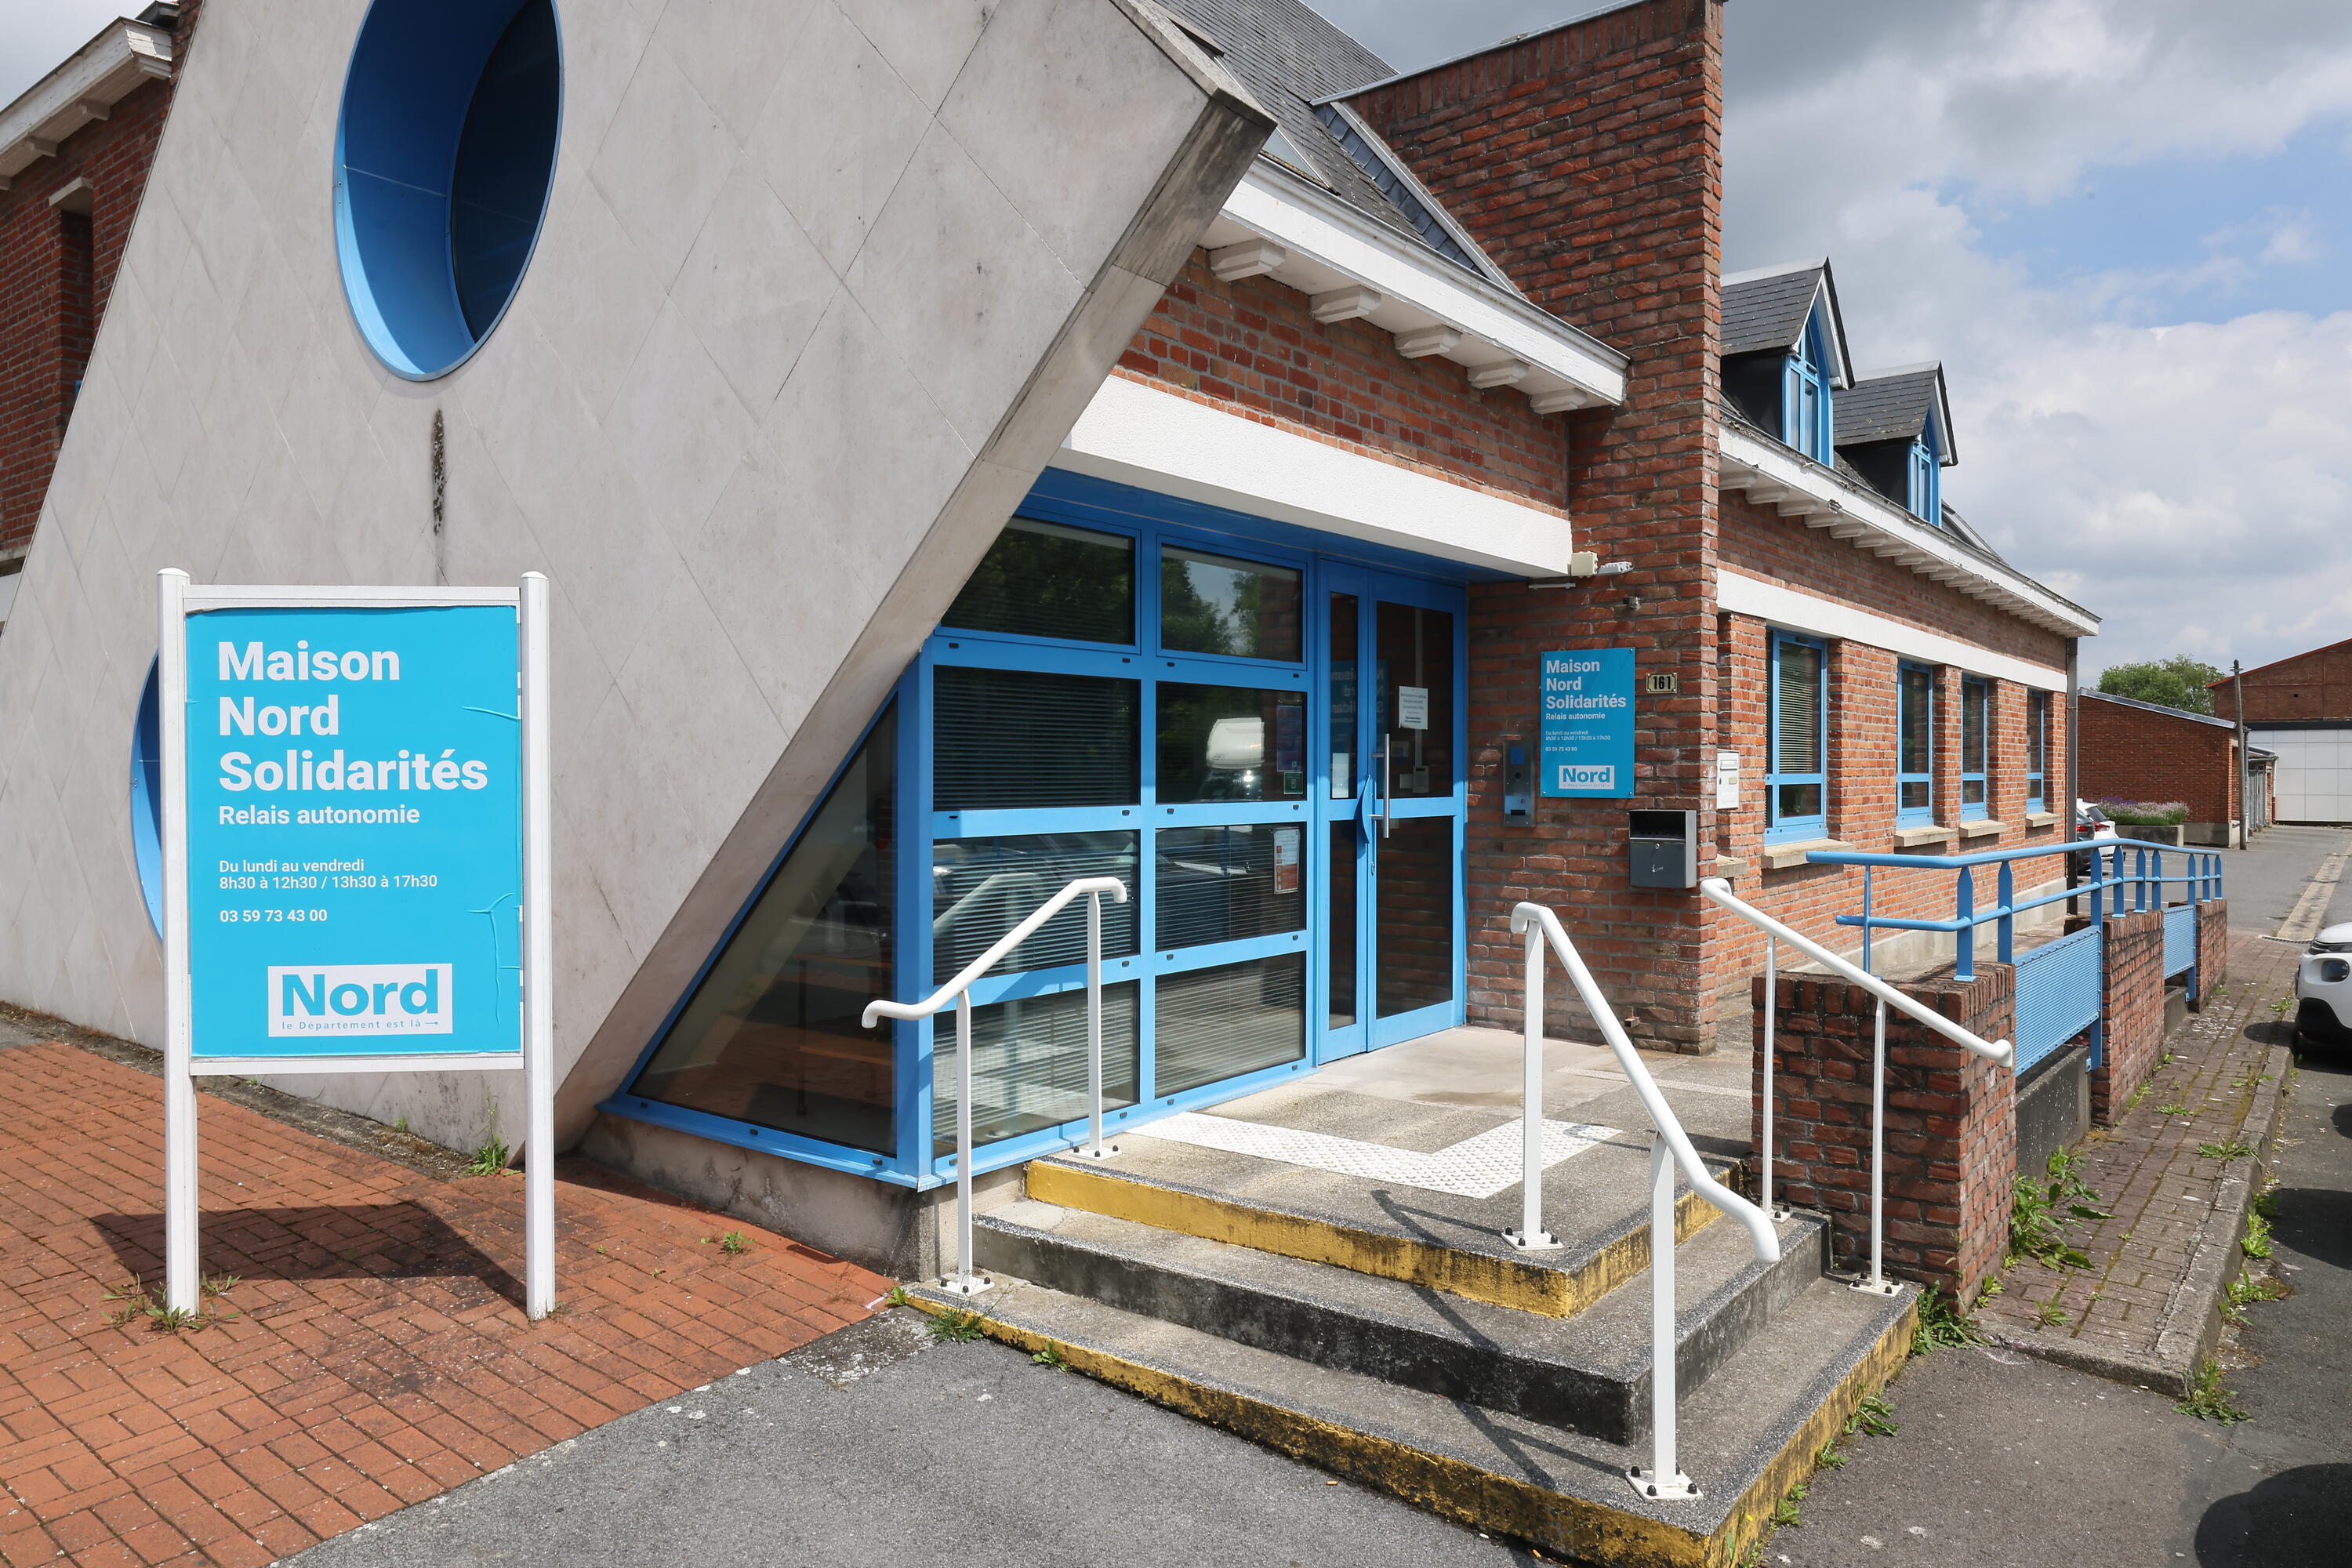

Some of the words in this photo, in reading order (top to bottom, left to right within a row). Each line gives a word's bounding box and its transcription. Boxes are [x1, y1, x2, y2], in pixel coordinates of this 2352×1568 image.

[219, 641, 400, 681] Maison
[1546, 659, 1600, 673] Maison
[1546, 677, 1581, 691] Nord
[1653, 676, 1671, 690] 161
[1546, 694, 1627, 709] Solidarités
[220, 695, 339, 735] Nord
[1568, 711, 1606, 720] autonomie
[220, 749, 488, 791] Solidarités
[1563, 767, 1610, 782] Nord
[220, 805, 289, 824] Relais
[297, 804, 419, 824] autonomie
[220, 861, 238, 872] Du
[243, 859, 277, 872] lundi
[282, 863, 299, 872] au
[303, 859, 364, 872] vendredi
[220, 877, 255, 889] 8h30
[260, 877, 268, 888] à
[273, 877, 317, 888] 12h30
[321, 877, 327, 888] /
[332, 876, 376, 887] 13h30
[381, 875, 389, 887] à
[394, 875, 437, 887] 17h30
[220, 910, 238, 922] 03
[243, 910, 260, 922] 59
[265, 910, 282, 921] 73
[287, 909, 305, 921] 43
[310, 909, 327, 921] 00
[283, 969, 437, 1016] Nord
[299, 1021, 379, 1031] Département
[387, 1020, 404, 1029] est
[411, 1018, 420, 1028] là
